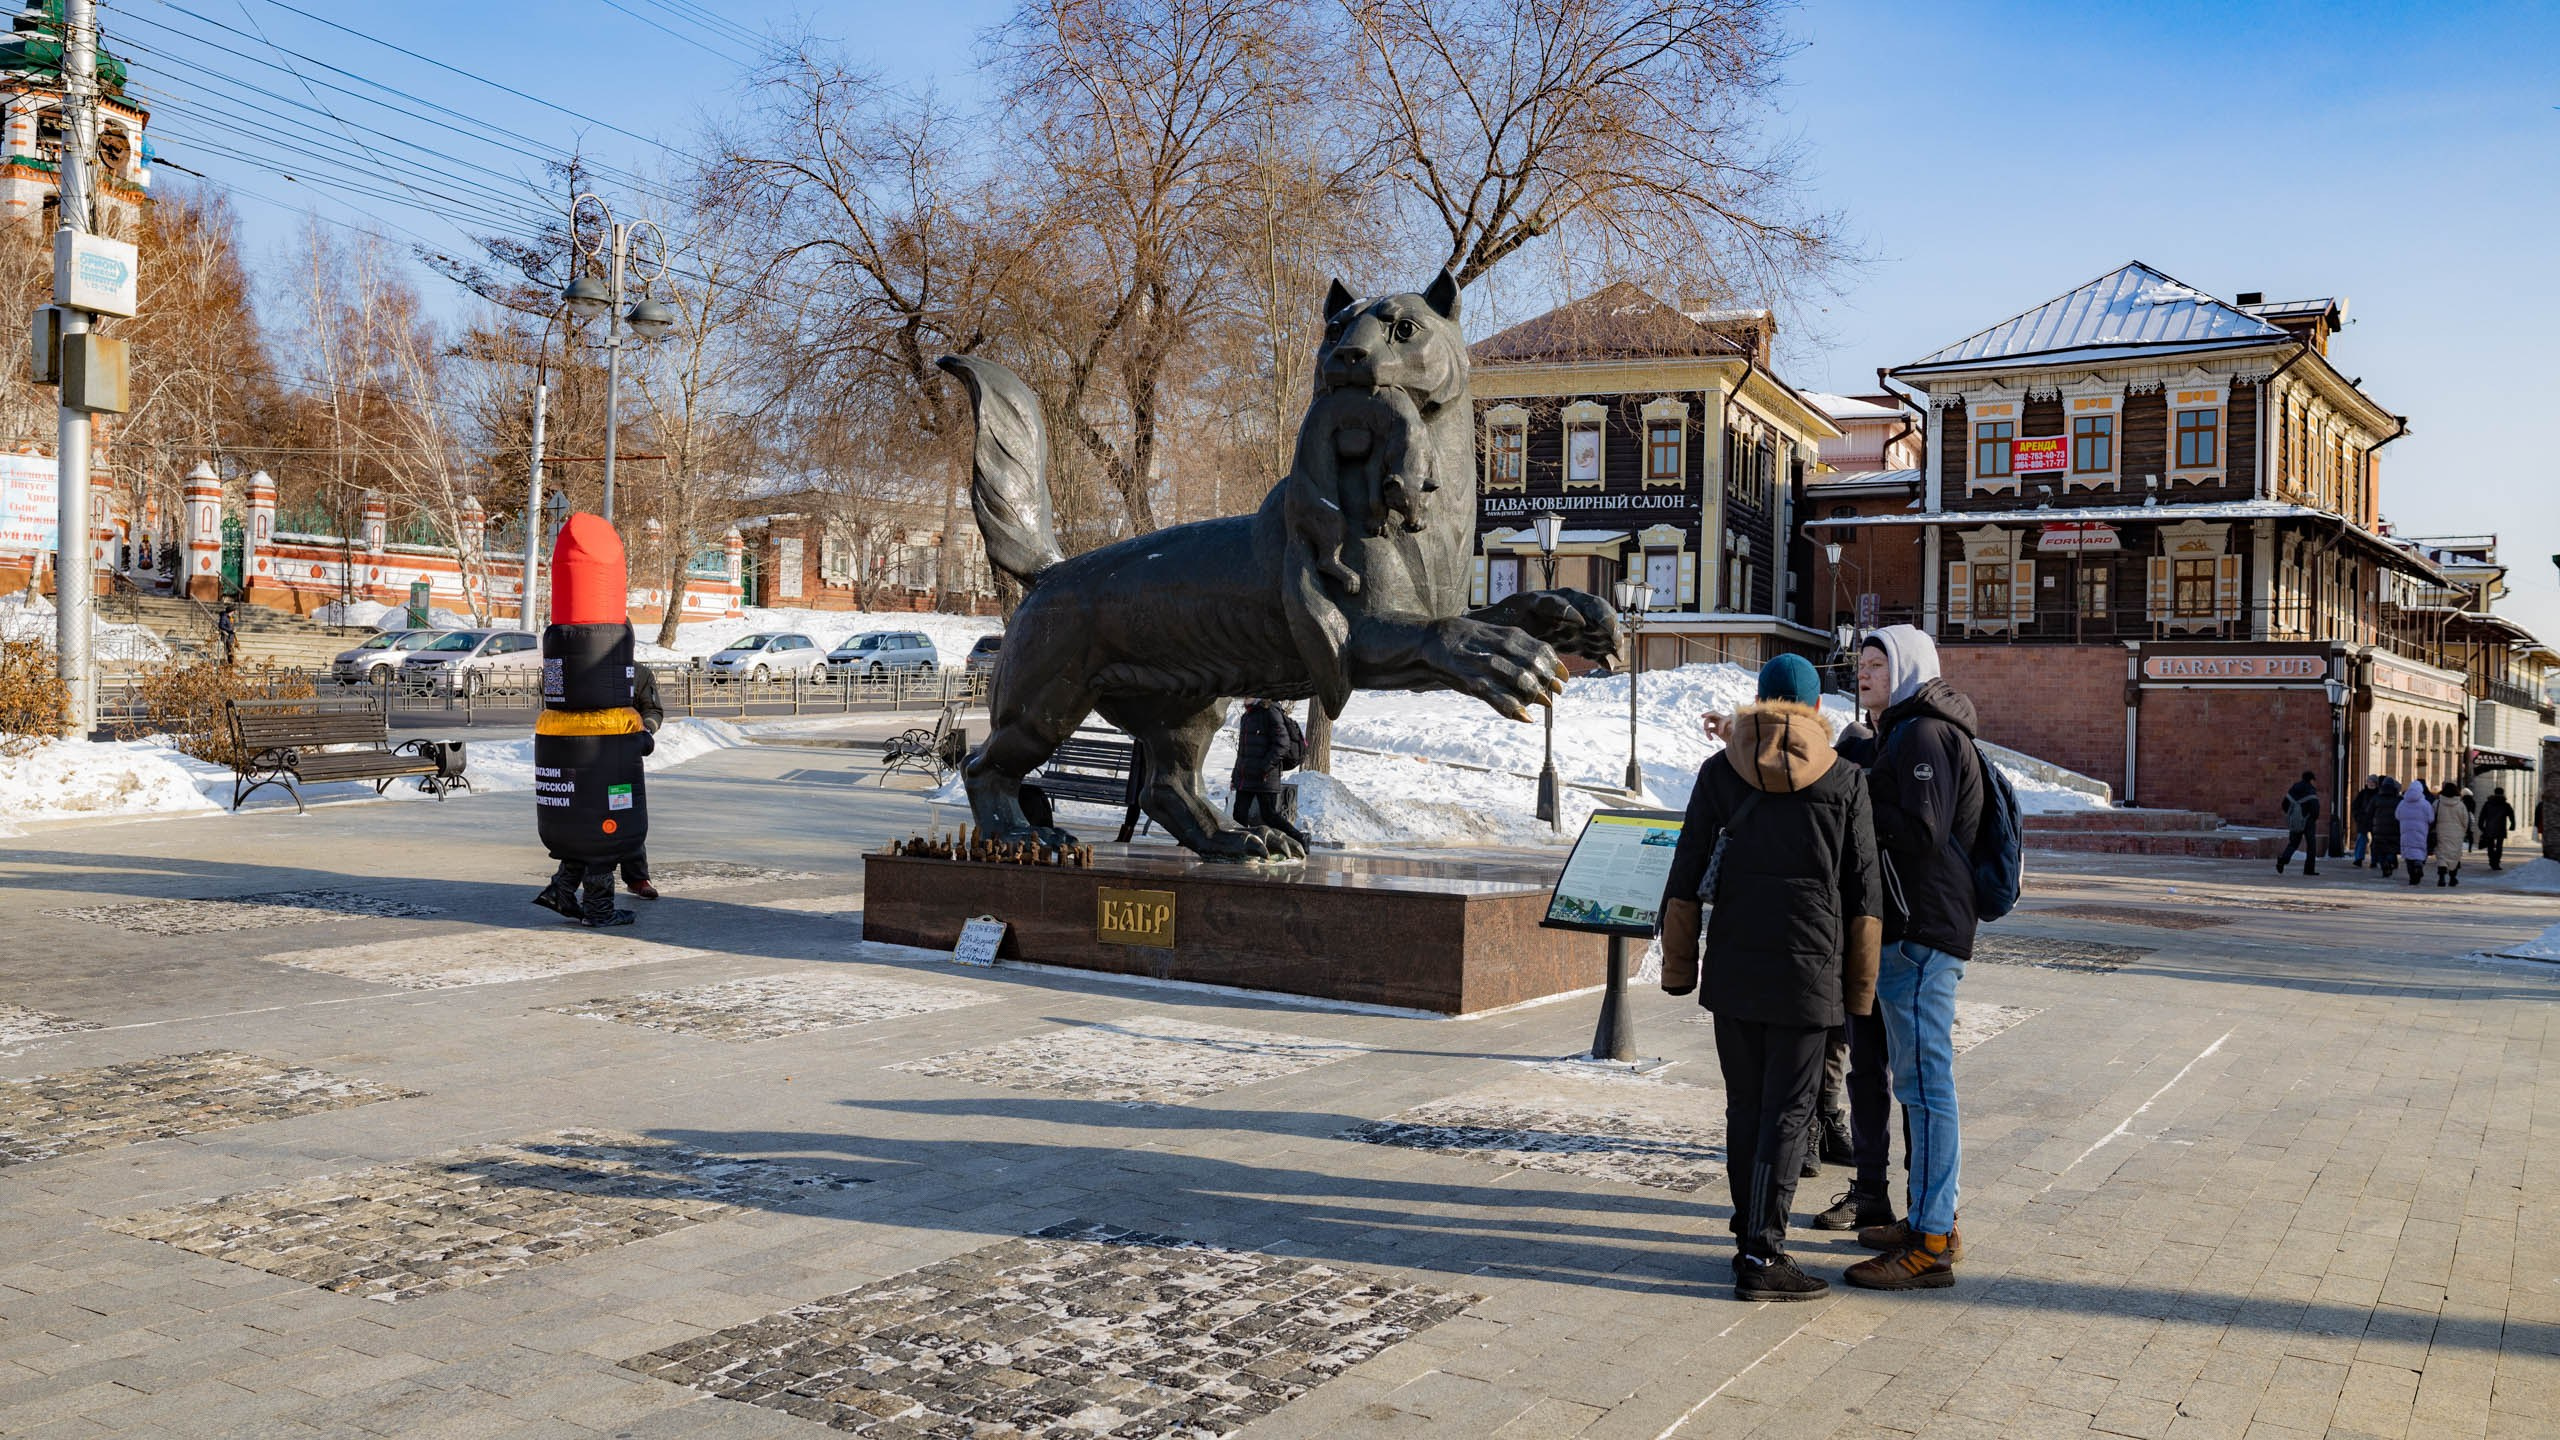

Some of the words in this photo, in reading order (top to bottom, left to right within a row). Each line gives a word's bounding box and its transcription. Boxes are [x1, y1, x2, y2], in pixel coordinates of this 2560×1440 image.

[2020, 440, 2057, 452] АРЕНДА
[1631, 494, 1685, 509] САЛОН
[2045, 537, 2113, 545] FORWARD
[2158, 659, 2253, 675] HARAT'S
[2265, 659, 2313, 675] PUB
